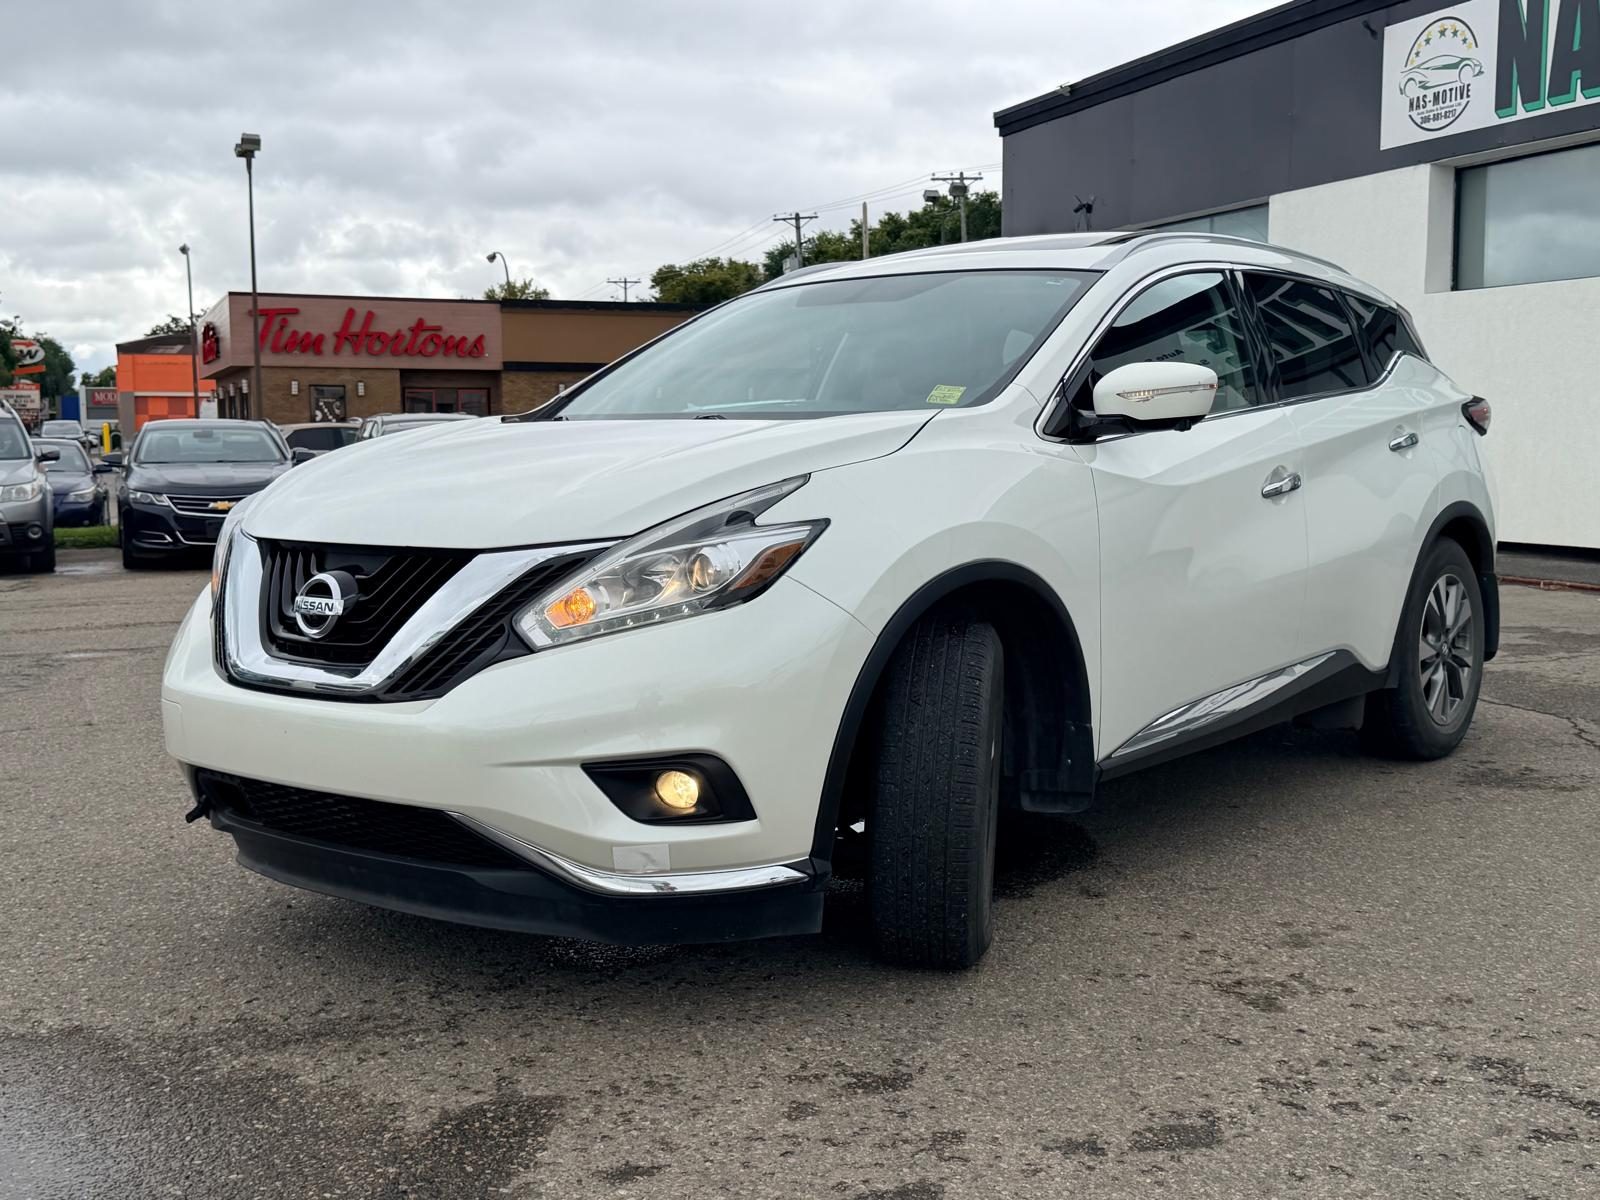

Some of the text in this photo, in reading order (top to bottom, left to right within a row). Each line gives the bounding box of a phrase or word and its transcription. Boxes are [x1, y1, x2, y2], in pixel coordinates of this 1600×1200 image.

[1408, 83, 1471, 112] NAS-MOTIVE
[248, 308, 325, 355] Tim
[333, 307, 485, 359] Hortons
[295, 599, 334, 612] NISSAN
